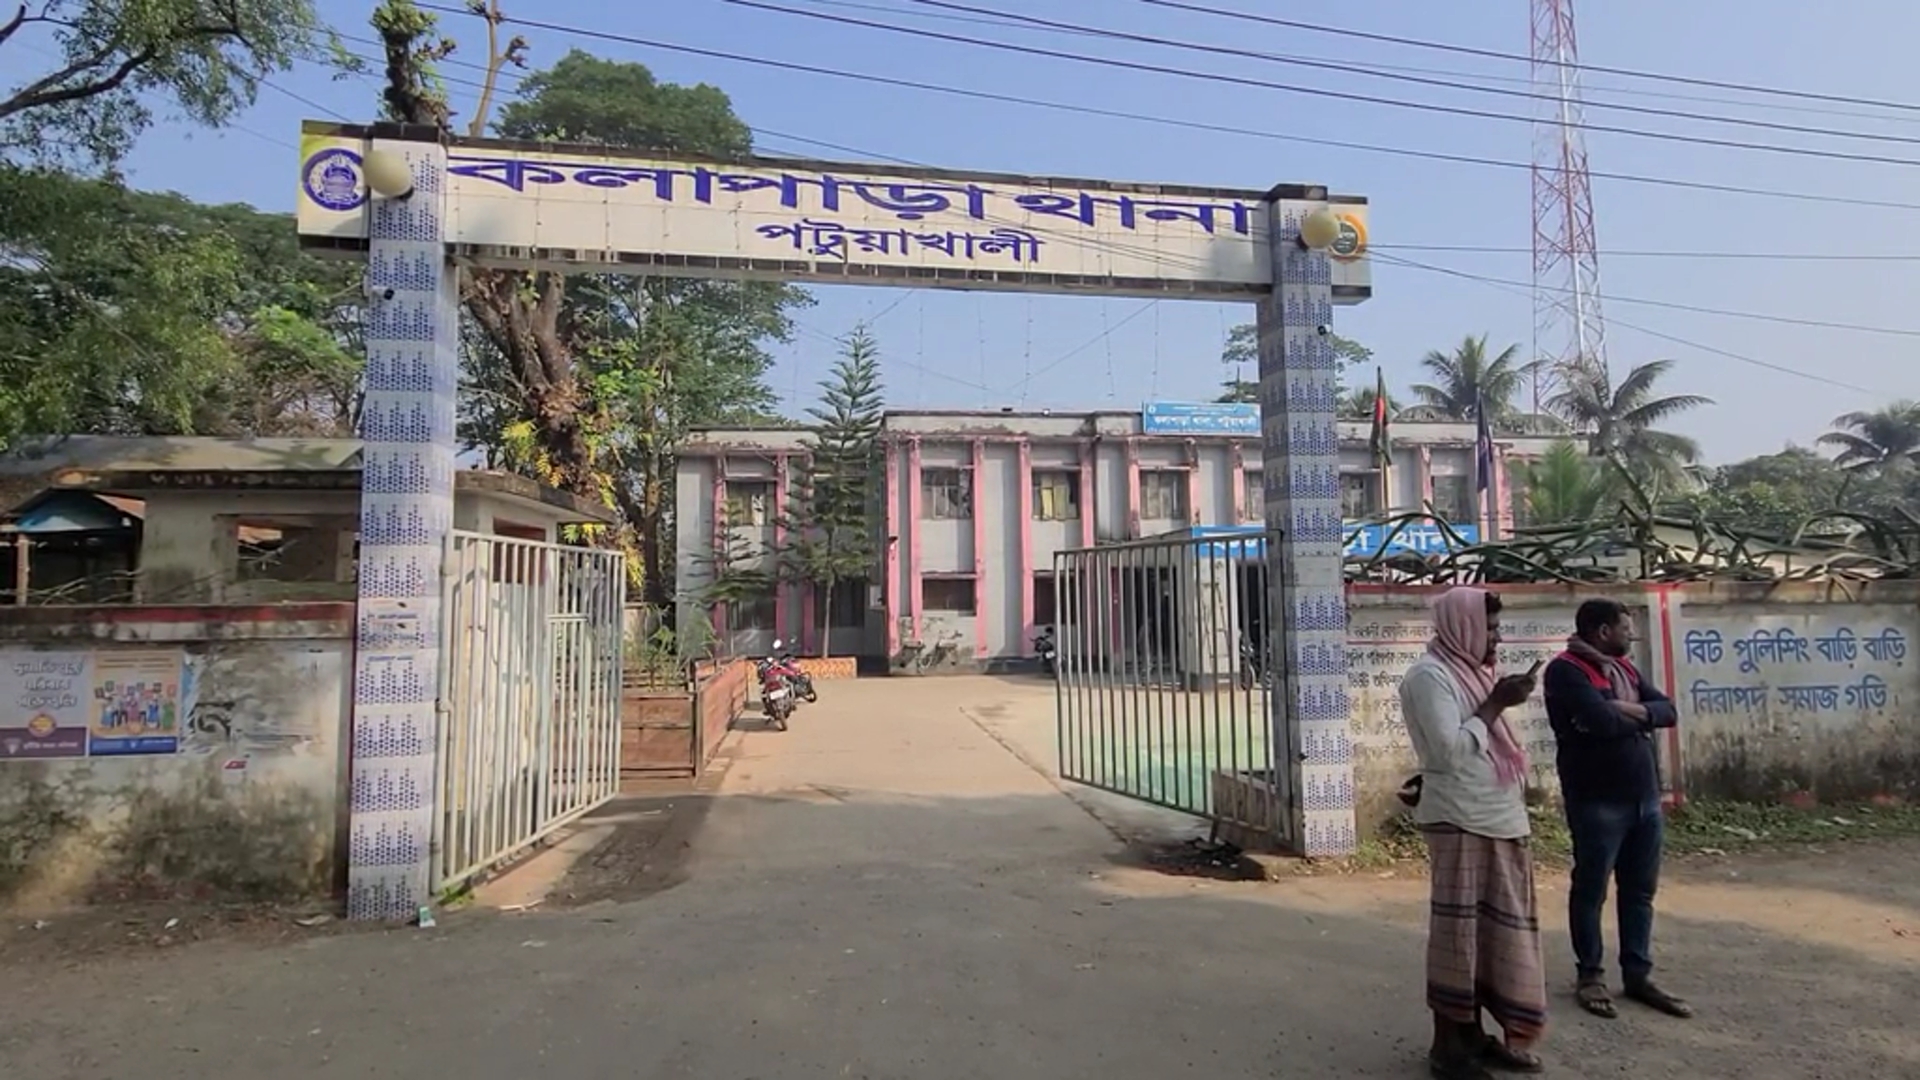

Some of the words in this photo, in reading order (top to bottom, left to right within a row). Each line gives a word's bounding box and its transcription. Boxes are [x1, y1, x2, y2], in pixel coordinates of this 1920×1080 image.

[447, 156, 996, 220] কলাপাড়া
[1014, 191, 1260, 236] থানা
[756, 218, 1047, 262] পটুয়াখালী
[1684, 629, 1724, 664] বিট
[1733, 627, 1811, 673] পুলিশিং
[1814, 627, 1858, 669] বাড়ি
[1862, 627, 1906, 667] বাড়ি
[1777, 684, 1840, 714] সমাজ
[1844, 674, 1888, 715] গড়ি
